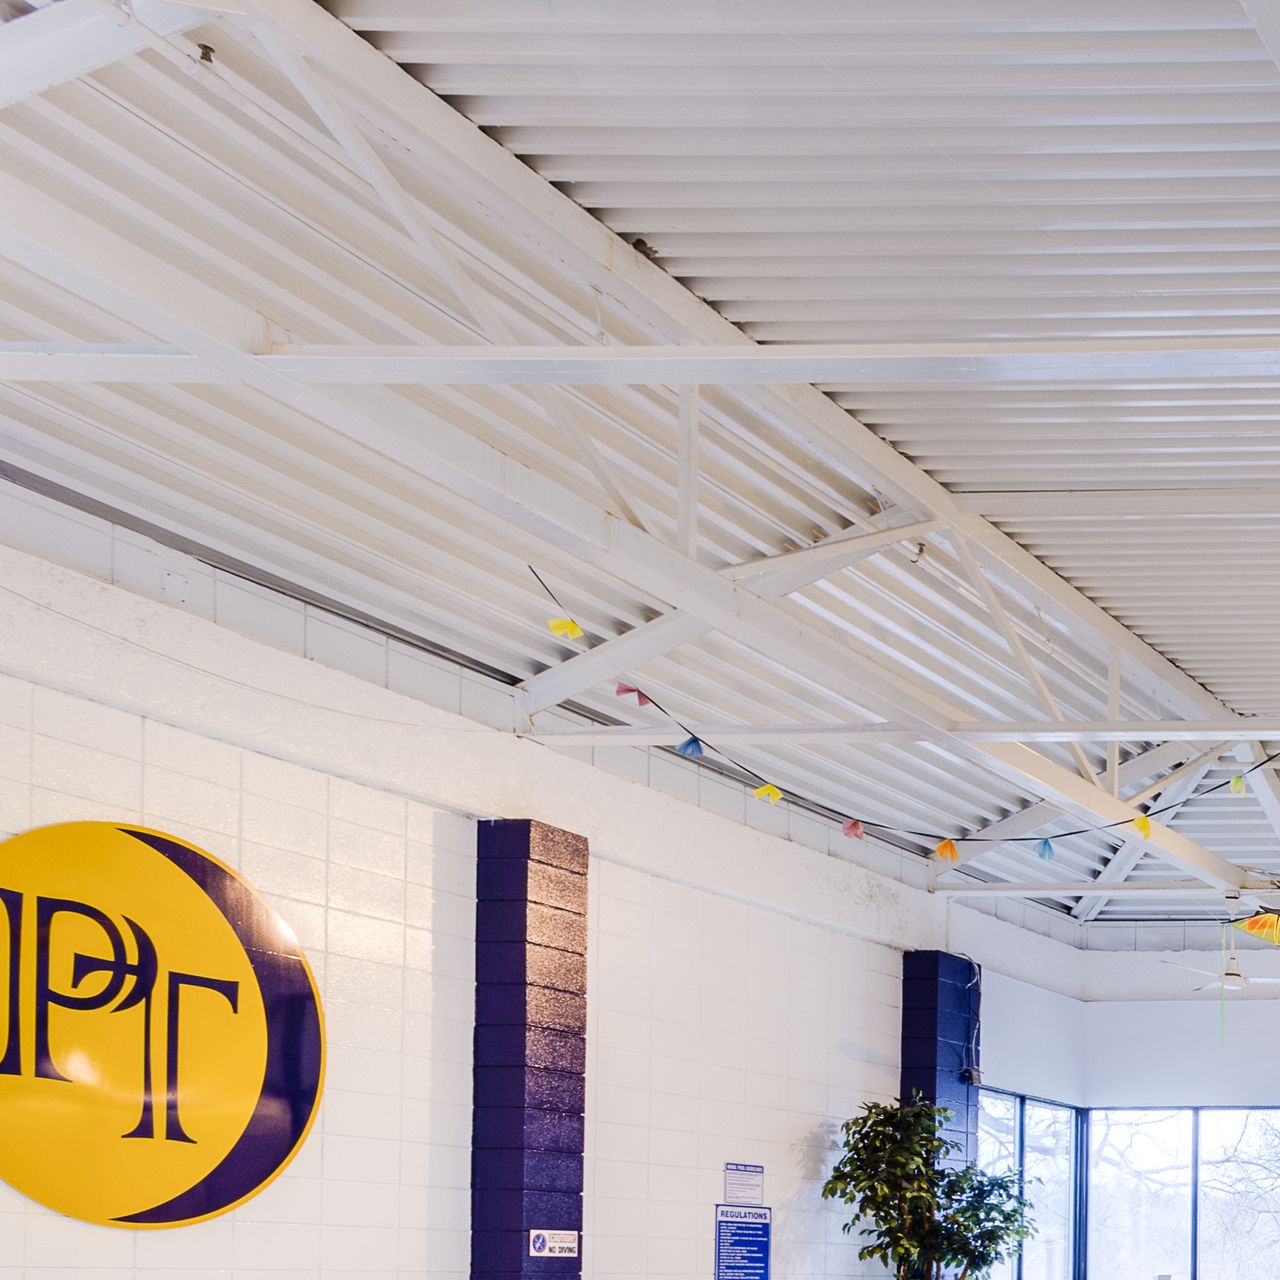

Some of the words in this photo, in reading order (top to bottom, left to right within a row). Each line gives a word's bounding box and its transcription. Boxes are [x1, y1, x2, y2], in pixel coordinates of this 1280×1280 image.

[720, 1210, 768, 1220] REGULATIONS
[548, 1246, 556, 1254] NO
[558, 1246, 576, 1254] DIVING
